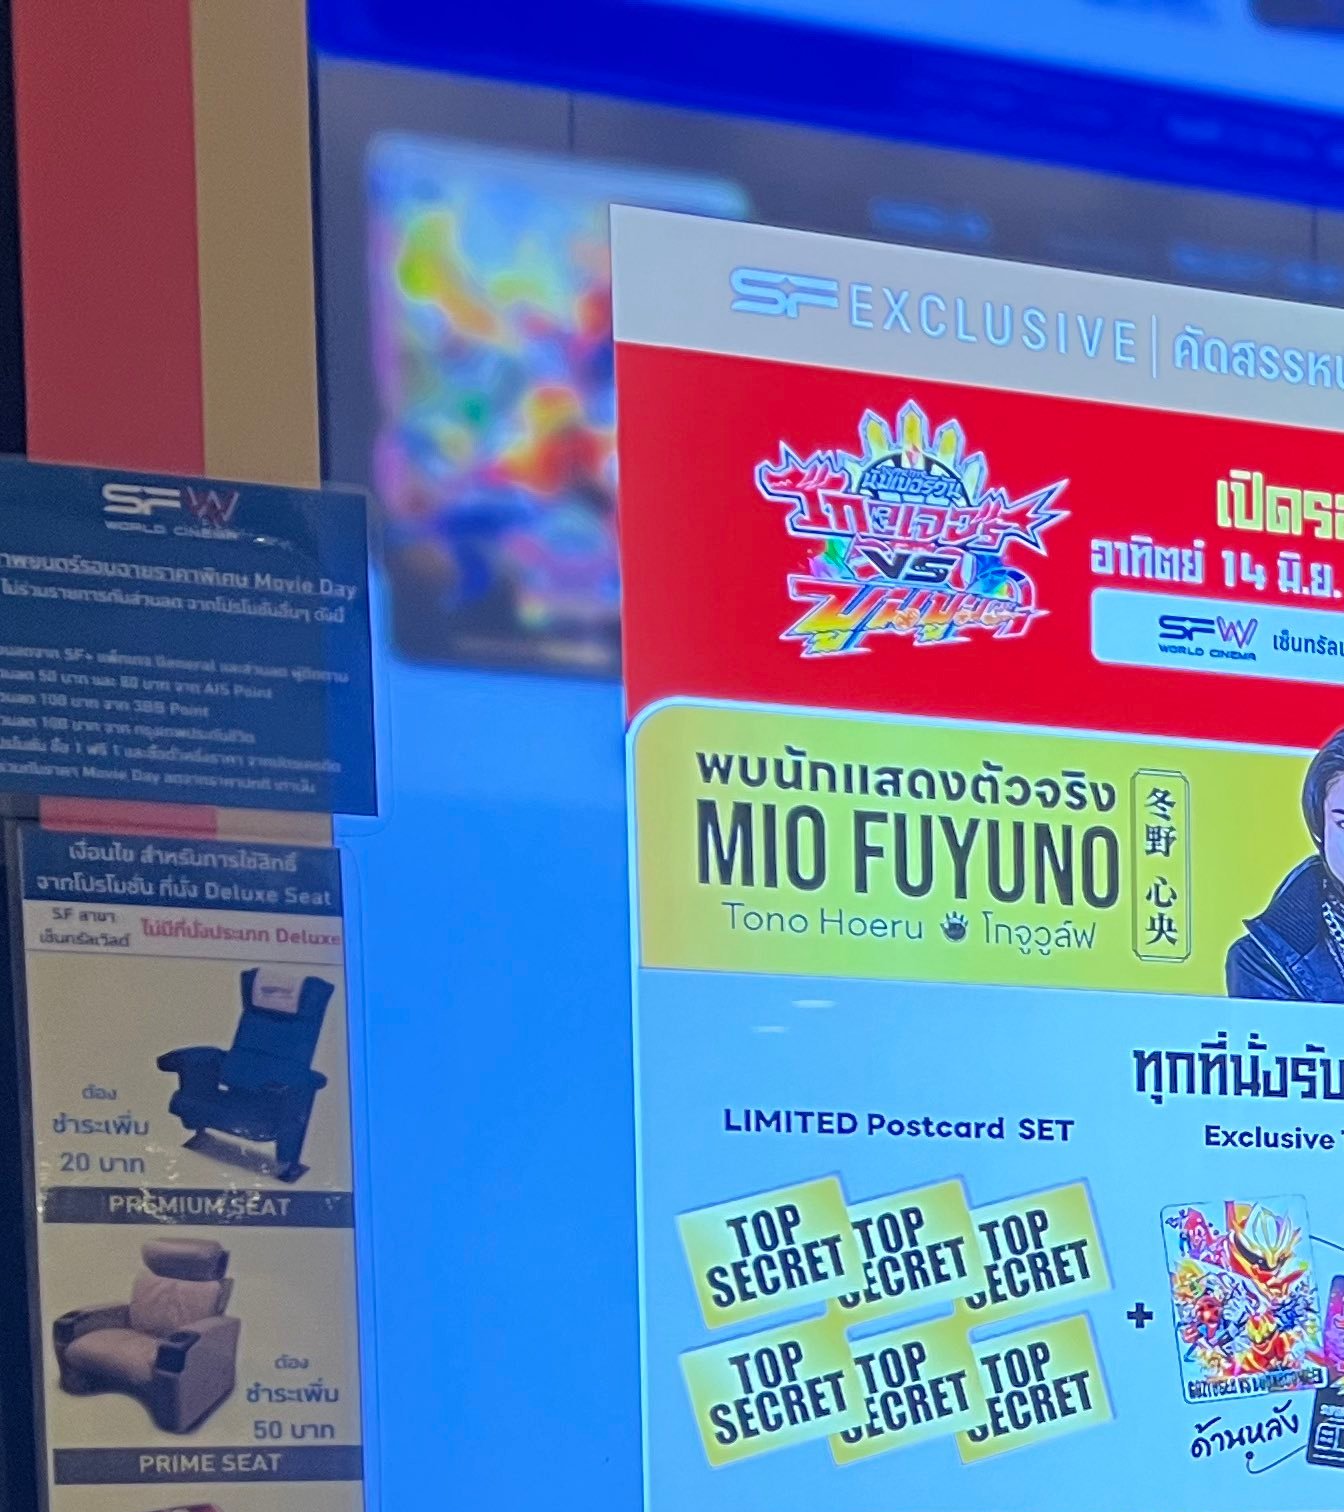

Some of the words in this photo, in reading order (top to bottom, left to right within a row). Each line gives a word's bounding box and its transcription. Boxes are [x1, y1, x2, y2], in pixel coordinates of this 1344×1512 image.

[730, 266, 840, 318] SF
[850, 283, 1136, 364] EXCLUSIVE
[857, 547, 960, 583] VS
[1091, 536, 1206, 583] อาทิตย์
[1222, 551, 1266, 590] 14
[1277, 552, 1342, 599] มิ.ย.
[255, 571, 313, 595] Movie
[320, 578, 358, 601] Day
[1158, 643, 1205, 658] WORLD
[1208, 648, 1257, 662] CINEMA
[233, 684, 272, 700] Point
[696, 744, 1117, 813] พบนักแสดงตัวจริง
[697, 799, 827, 891] MIO
[853, 809, 1120, 909] FUYUNO
[204, 881, 279, 903] Deluxe
[284, 885, 333, 907] Seat
[52, 907, 73, 921] SF
[722, 901, 809, 935] Tono
[820, 908, 924, 940] Hoeru
[981, 910, 1098, 956] โกจูวูล์ฟ
[276, 928, 342, 947] Deluxe
[52, 1109, 150, 1136] ชำระเพิ่ม
[724, 1107, 858, 1135] LIMITED
[867, 1112, 1004, 1141] Postcard
[1019, 1119, 1075, 1142] SET
[1204, 1124, 1335, 1151] Exclusive
[60, 1152, 91, 1172] 20
[99, 1155, 146, 1174] บาท
[108, 1194, 231, 1215] PREMIUM
[233, 1196, 292, 1217] SEAT
[726, 1204, 802, 1258] TOP
[850, 1206, 925, 1261] TOP
[978, 1209, 1050, 1262] TOP
[706, 1234, 847, 1309] SECRET
[728, 1340, 804, 1395] TOP
[855, 1341, 927, 1396] TOP
[980, 1342, 1052, 1395] TOP
[246, 1376, 340, 1404] ชำระเพิ่ม
[708, 1370, 848, 1446] SECRET
[253, 1421, 283, 1441] 50
[291, 1422, 336, 1441] บาท
[1189, 1400, 1301, 1459] ด้านหลัง
[138, 1454, 216, 1474] PRIME
[223, 1454, 283, 1472] SEAT
